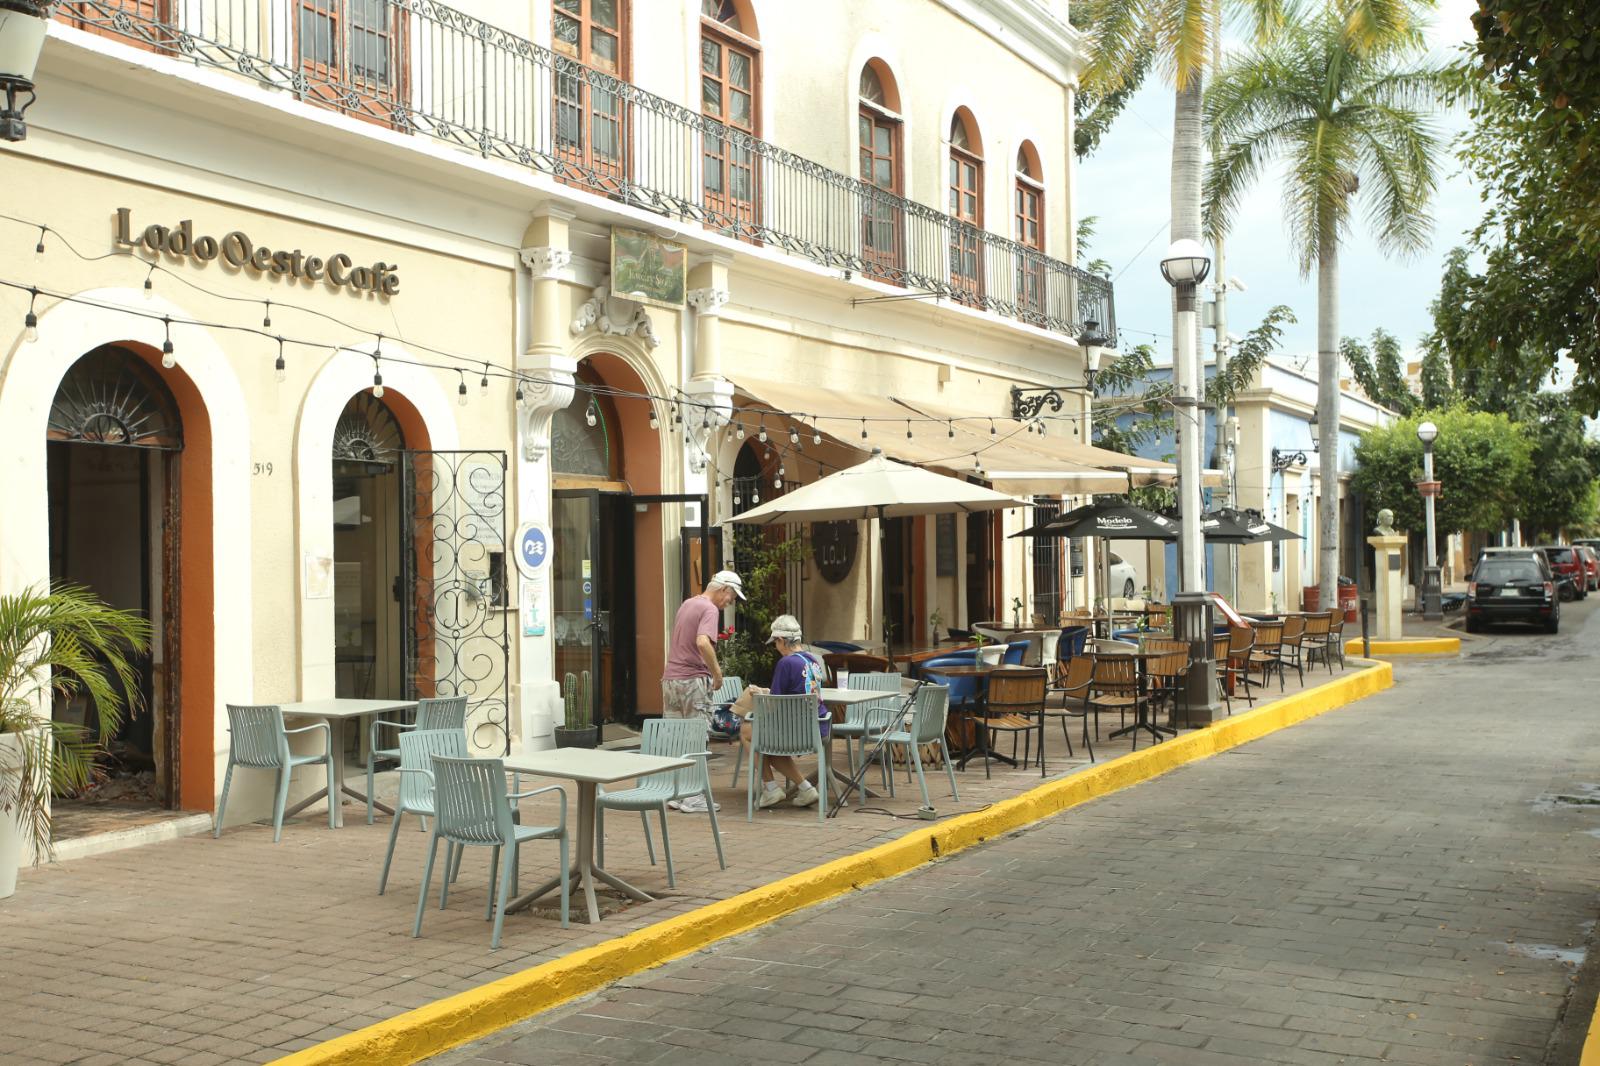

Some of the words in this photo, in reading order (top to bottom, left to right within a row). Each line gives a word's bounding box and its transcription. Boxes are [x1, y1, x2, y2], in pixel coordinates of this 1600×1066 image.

[116, 207, 219, 261] Lado
[222, 231, 325, 281] Oeste
[327, 253, 400, 296] Café
[1096, 517, 1133, 525] Modelo
